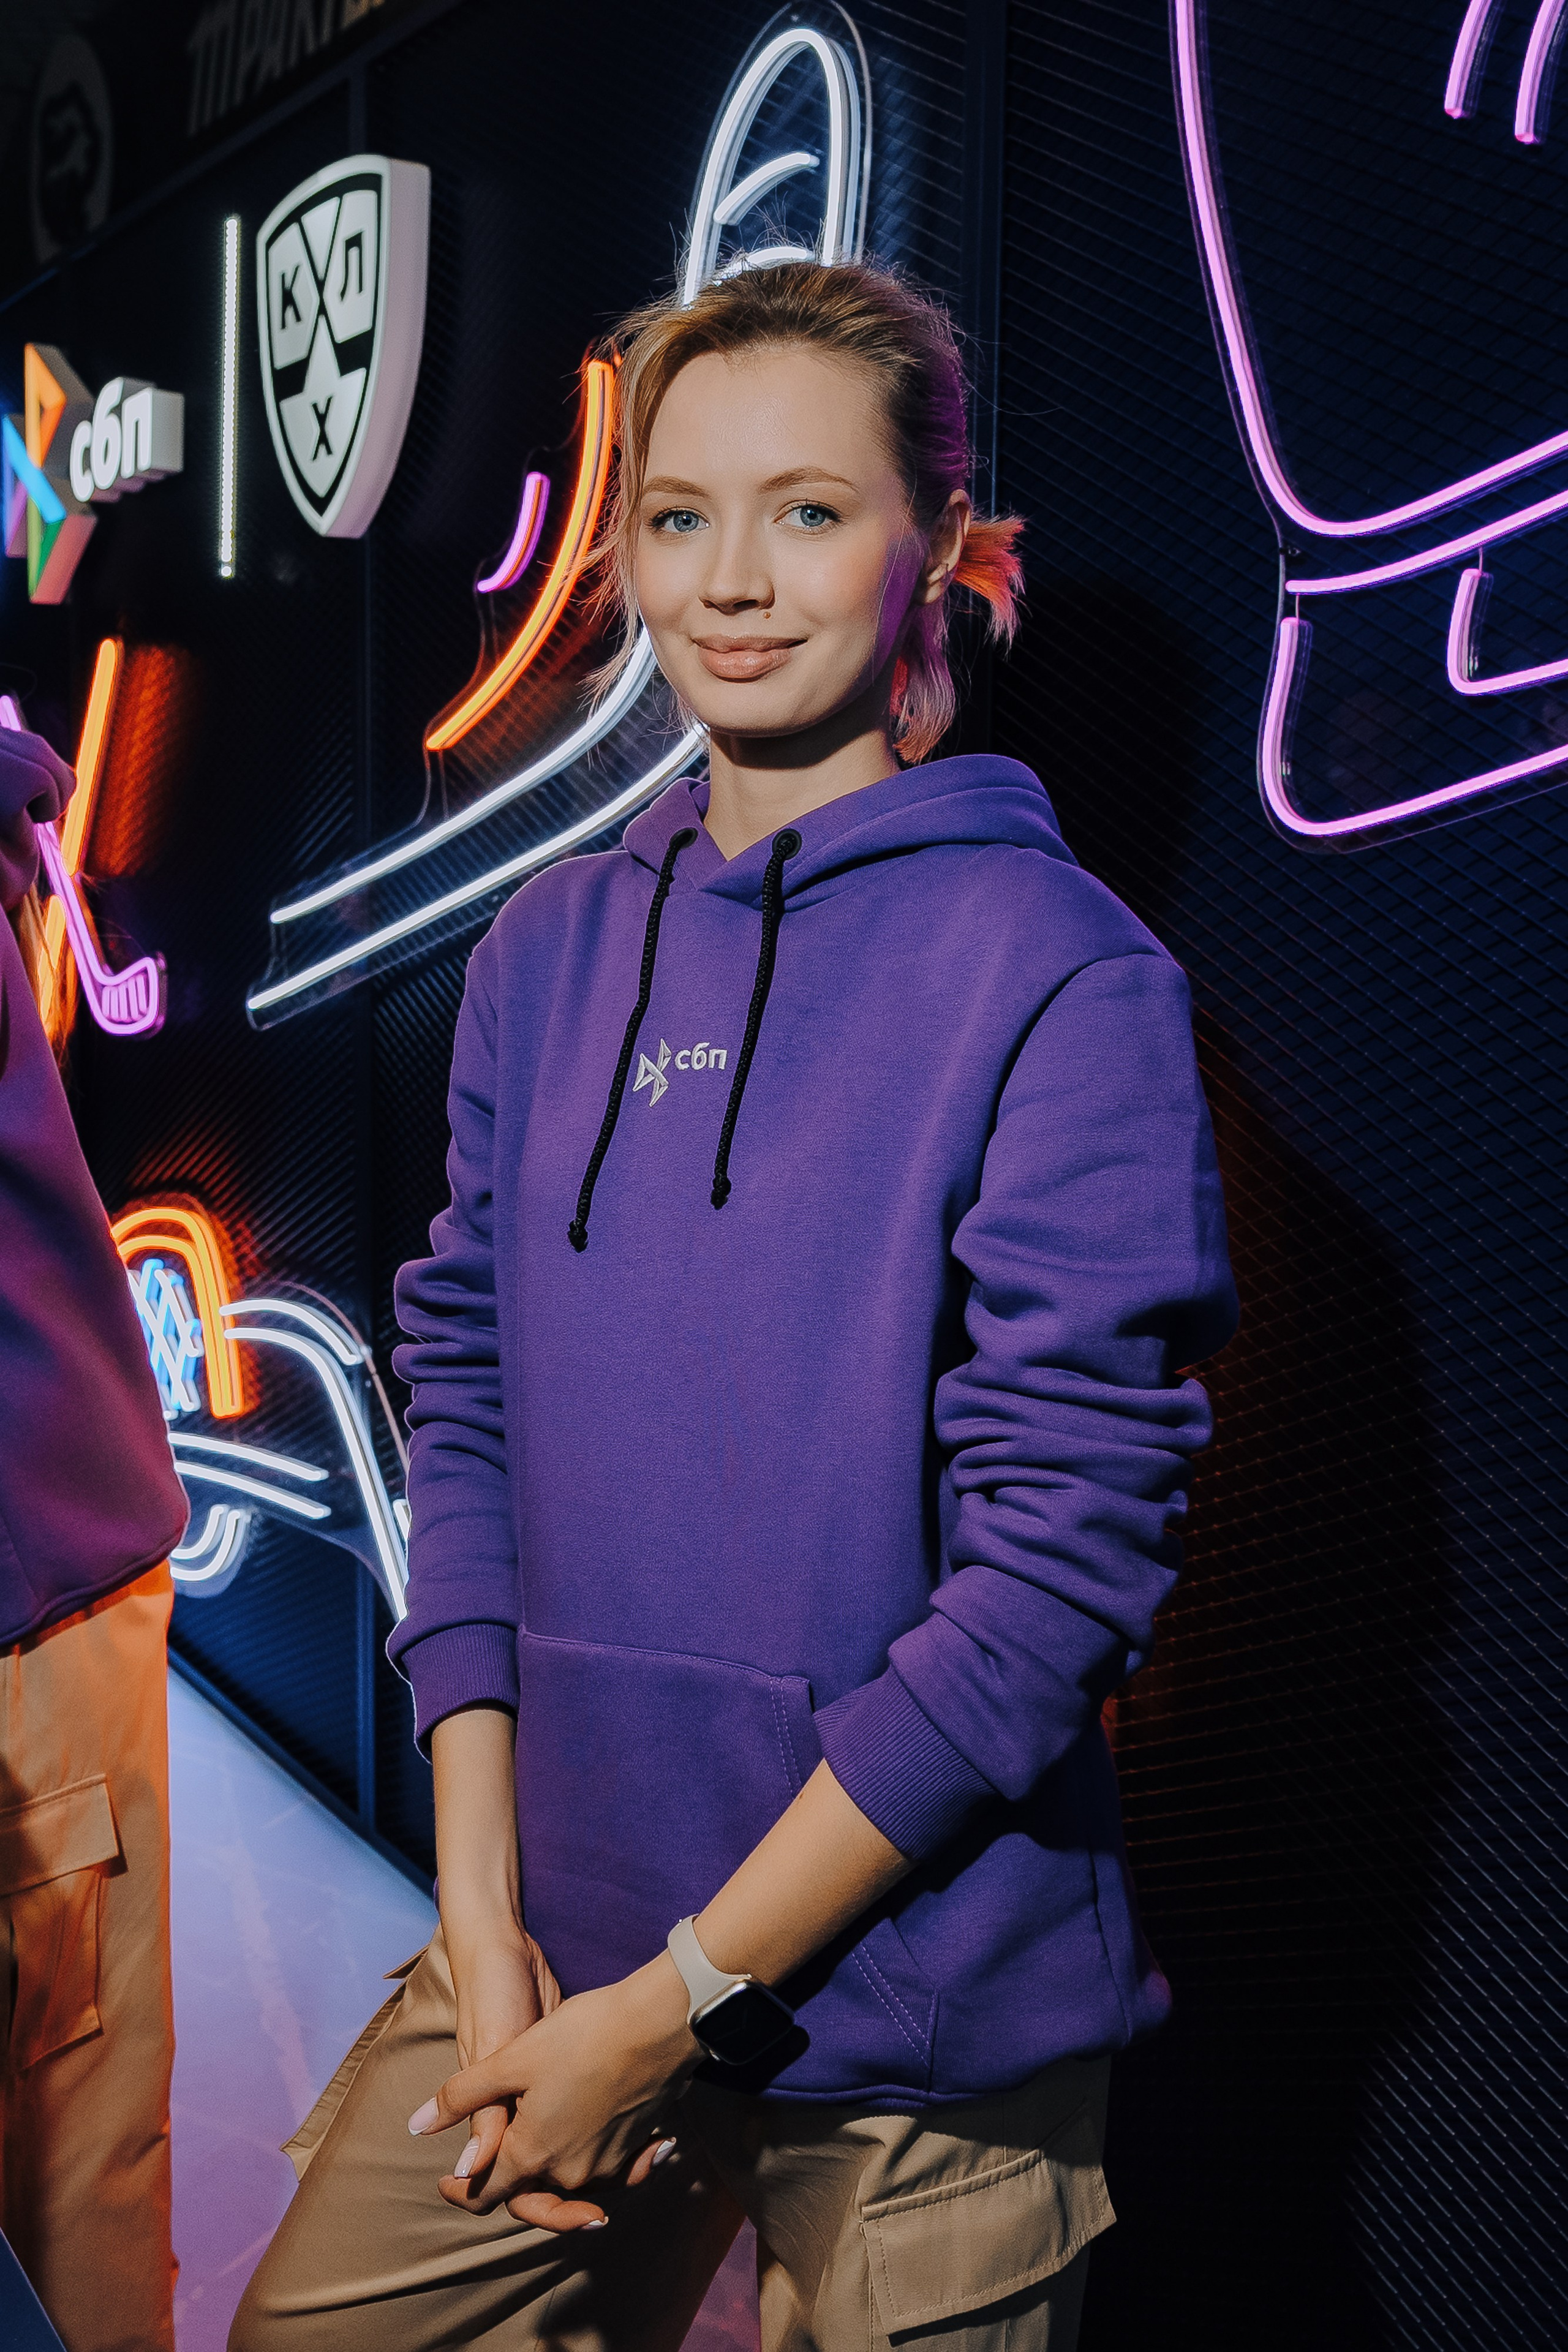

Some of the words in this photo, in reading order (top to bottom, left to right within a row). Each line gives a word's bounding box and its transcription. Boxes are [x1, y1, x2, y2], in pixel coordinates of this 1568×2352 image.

[281, 263, 302, 330] К
[339, 231, 364, 303] Л
[70, 376, 153, 503] сбп
[311, 395, 333, 461] Х
[674, 1042, 728, 1071] сбп
